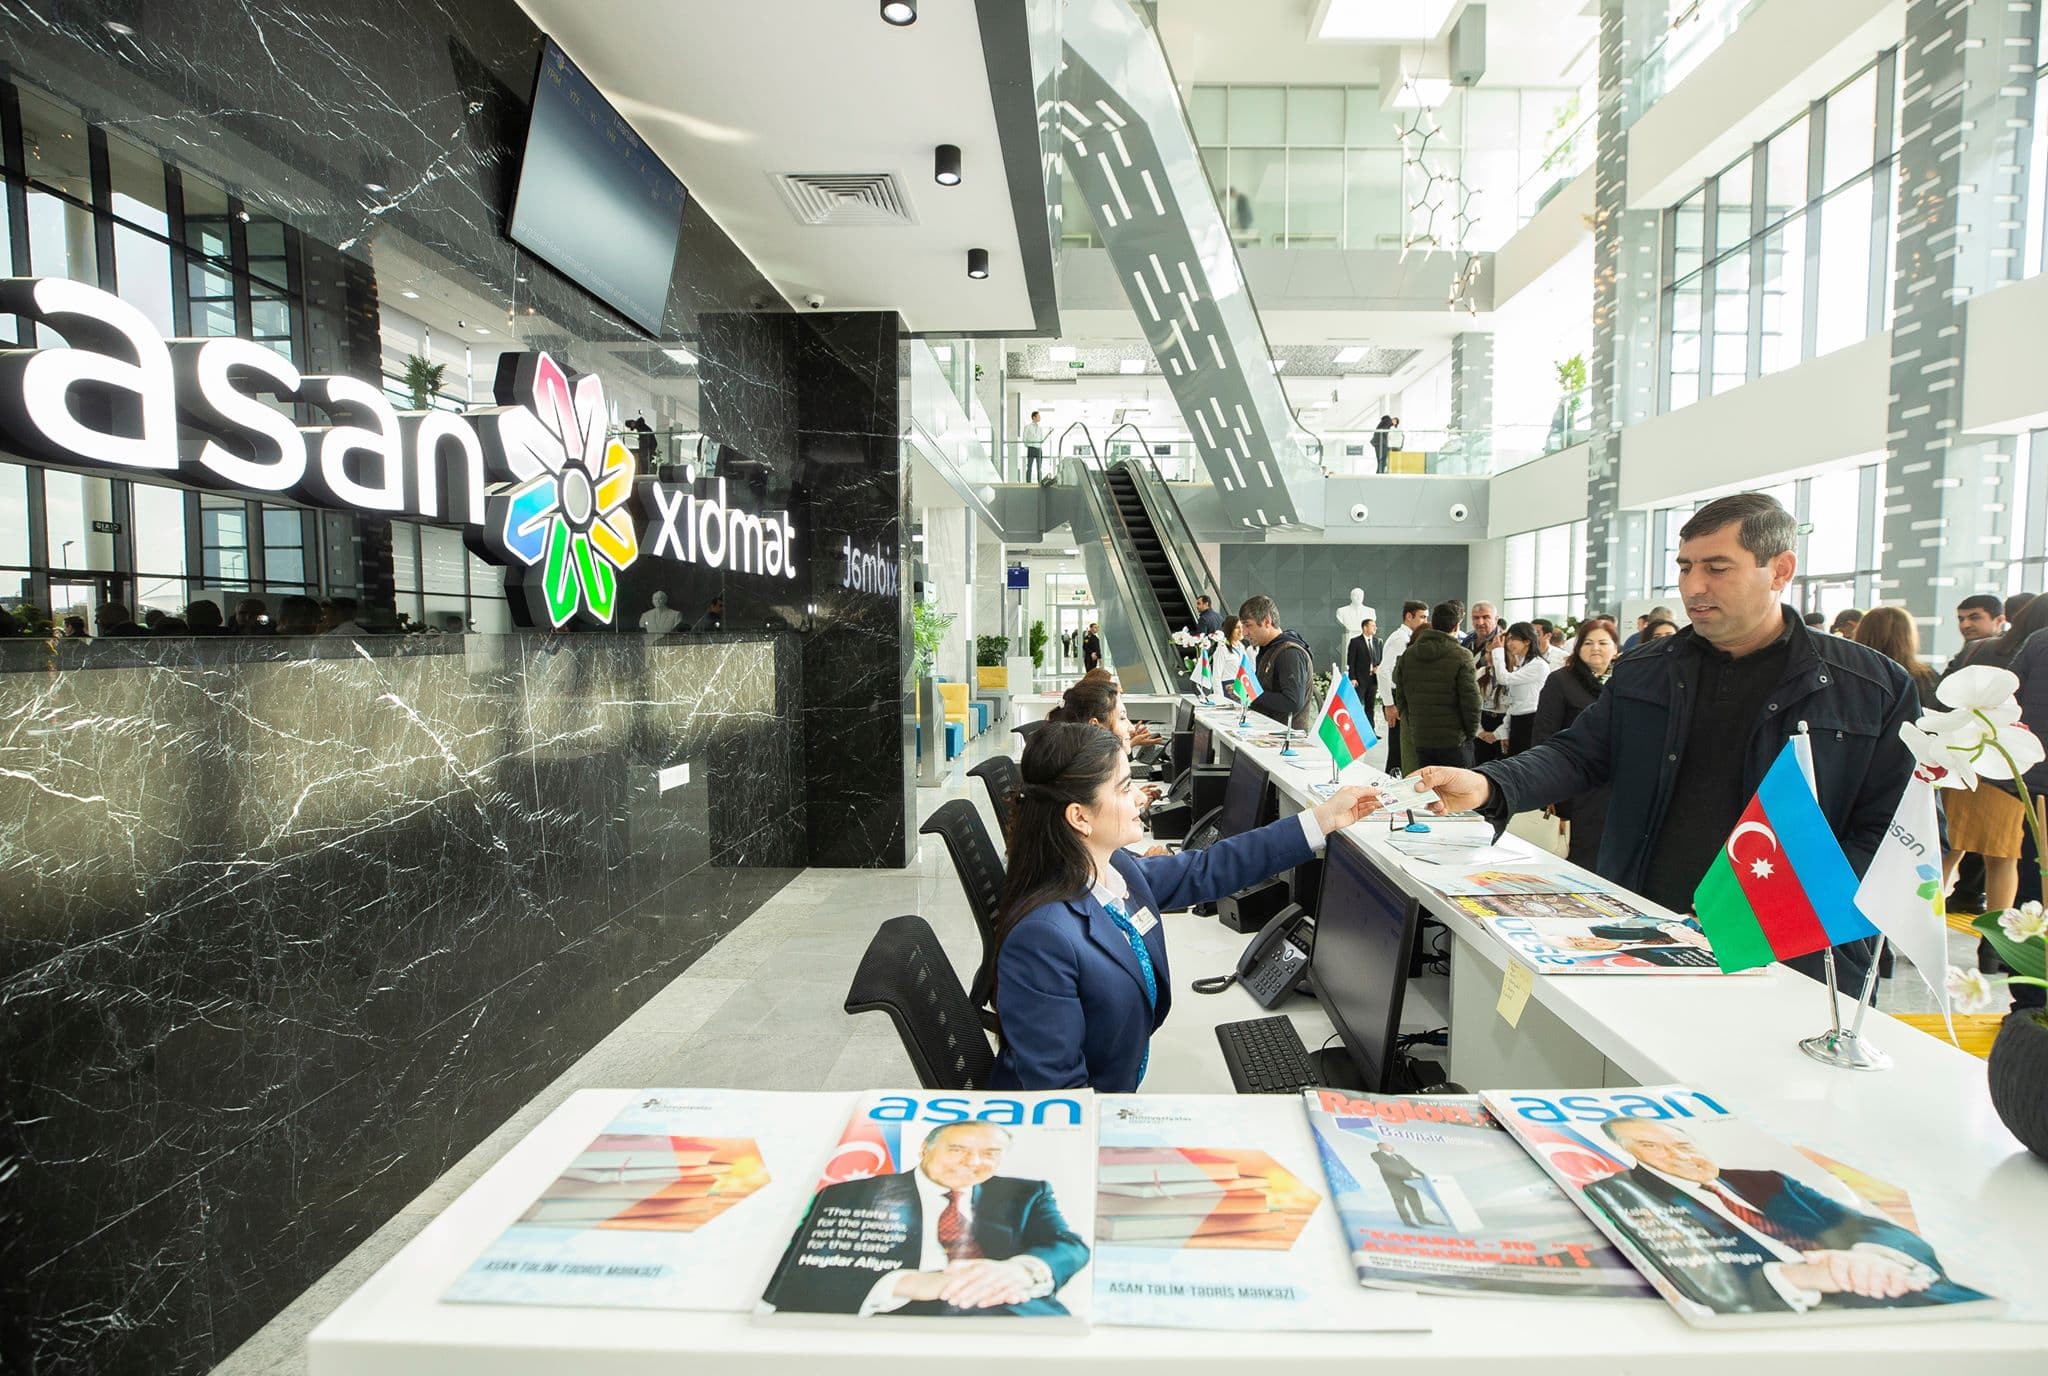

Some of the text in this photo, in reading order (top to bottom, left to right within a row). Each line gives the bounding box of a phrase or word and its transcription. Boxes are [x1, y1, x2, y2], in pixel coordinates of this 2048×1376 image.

[23, 277, 485, 525] asan
[868, 1096, 1081, 1125] asan
[1510, 1091, 1730, 1123] asan
[852, 1208, 887, 1219] state
[817, 1217, 836, 1228] for
[838, 1218, 861, 1229] the
[811, 1228, 907, 1243] not the people
[807, 1239, 826, 1250] for
[828, 1239, 852, 1251] the
[798, 1254, 904, 1272] Heydar Aliyev
[1109, 1282, 1143, 1295] ASAN
